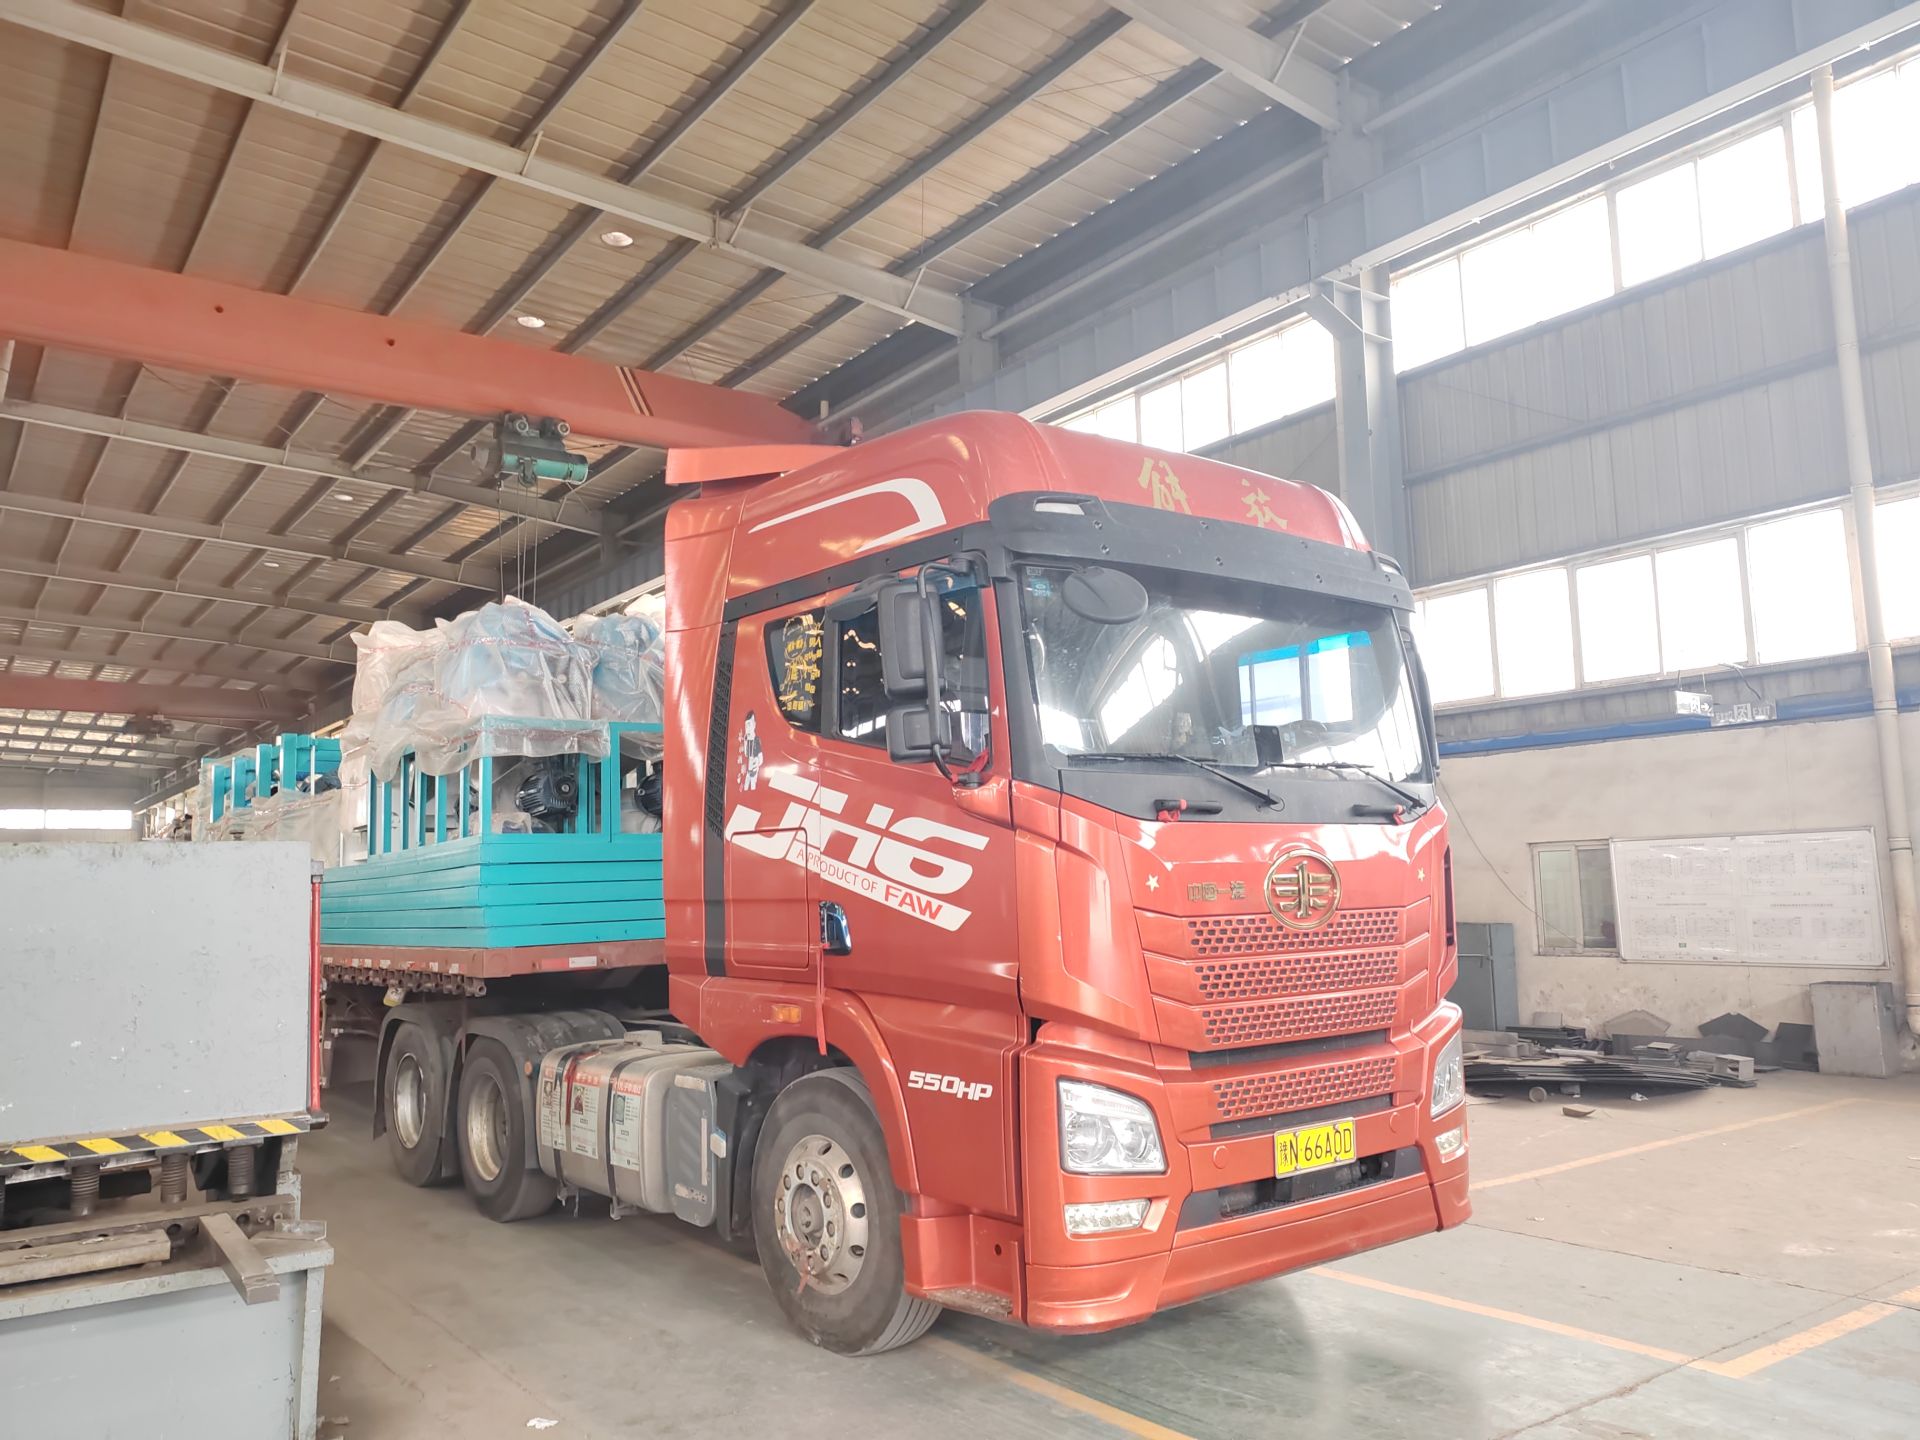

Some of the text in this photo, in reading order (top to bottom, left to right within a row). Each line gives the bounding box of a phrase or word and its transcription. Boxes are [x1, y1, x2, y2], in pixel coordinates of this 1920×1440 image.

[1752, 706, 1770, 717] EXIT
[796, 848, 944, 921] A PRODUCT OF FAW
[907, 1070, 993, 1101] 550HP
